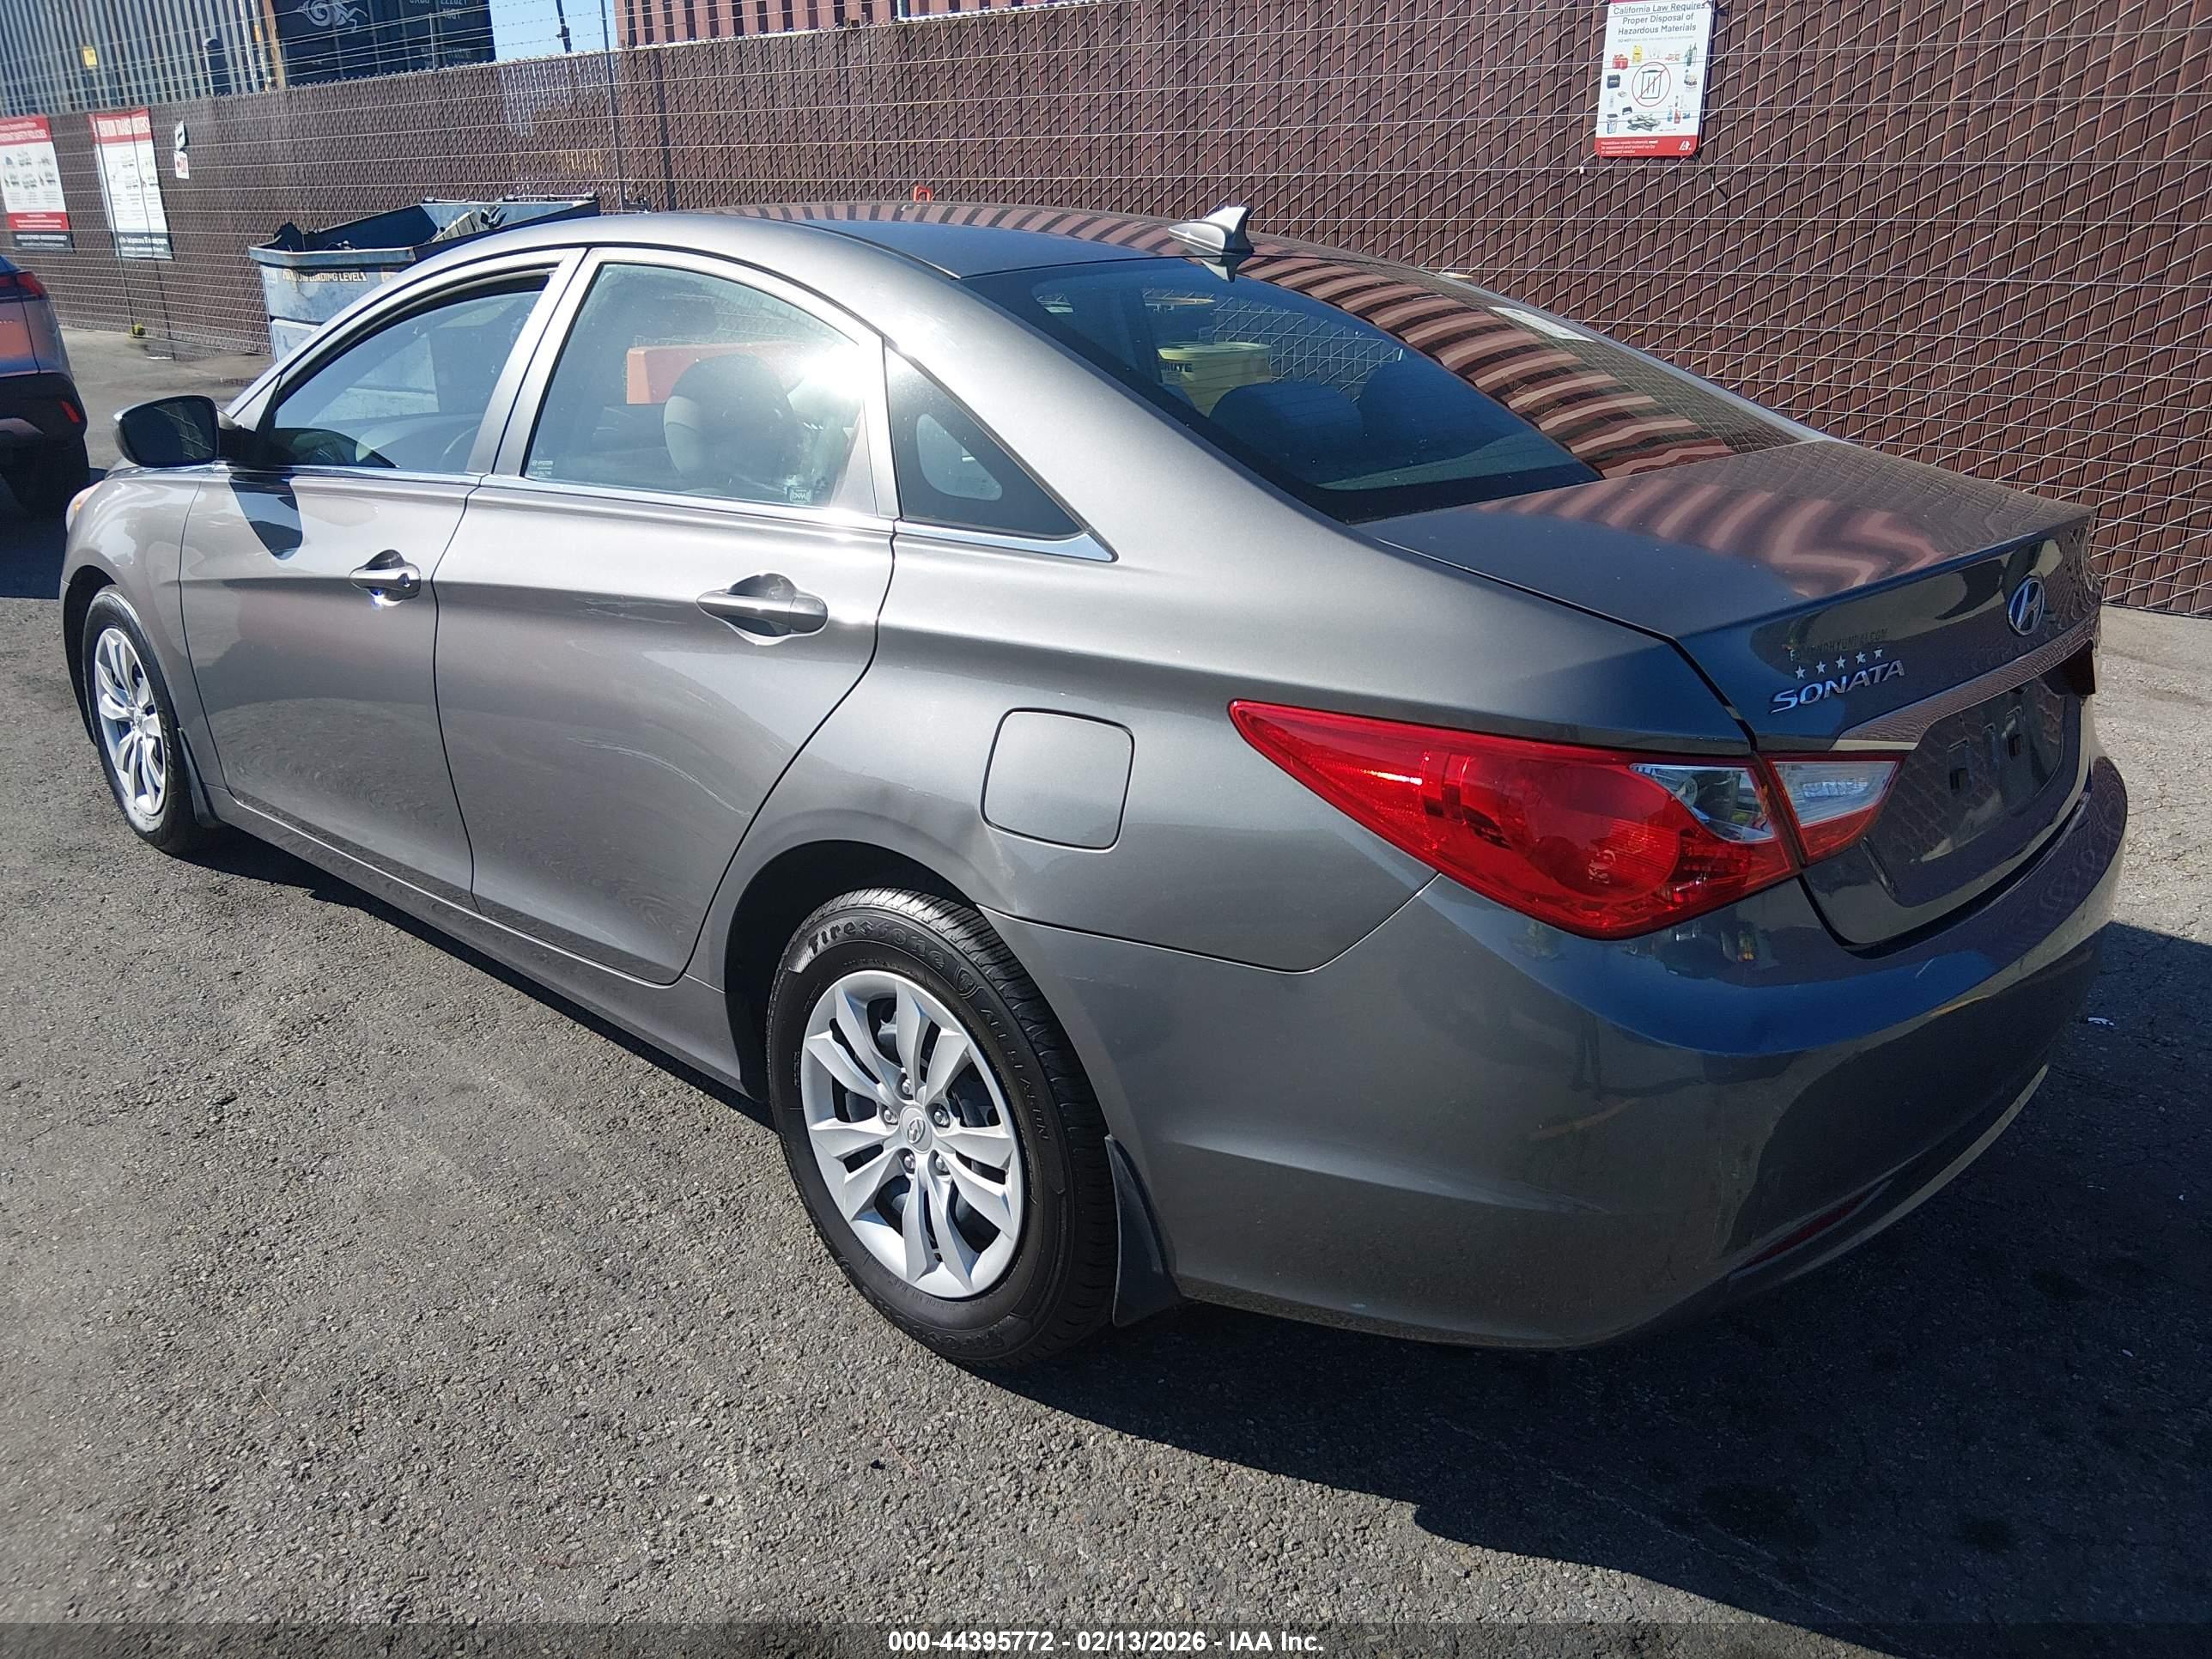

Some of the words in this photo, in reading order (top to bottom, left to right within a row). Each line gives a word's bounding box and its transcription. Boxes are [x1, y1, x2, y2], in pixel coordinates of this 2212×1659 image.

[1613, 6, 1650, 15] California
[1670, 3, 1705, 11] Requires
[1622, 16, 1649, 25] Proper
[1650, 13, 1684, 23] Disposal
[1686, 12, 1694, 21] of
[1618, 26, 1659, 35] Hazardous
[1661, 23, 1697, 33] Materials
[338, 271, 362, 282] LEVEL
[1771, 659, 1905, 714] SONATA
[807, 920, 945, 970] Firestone
